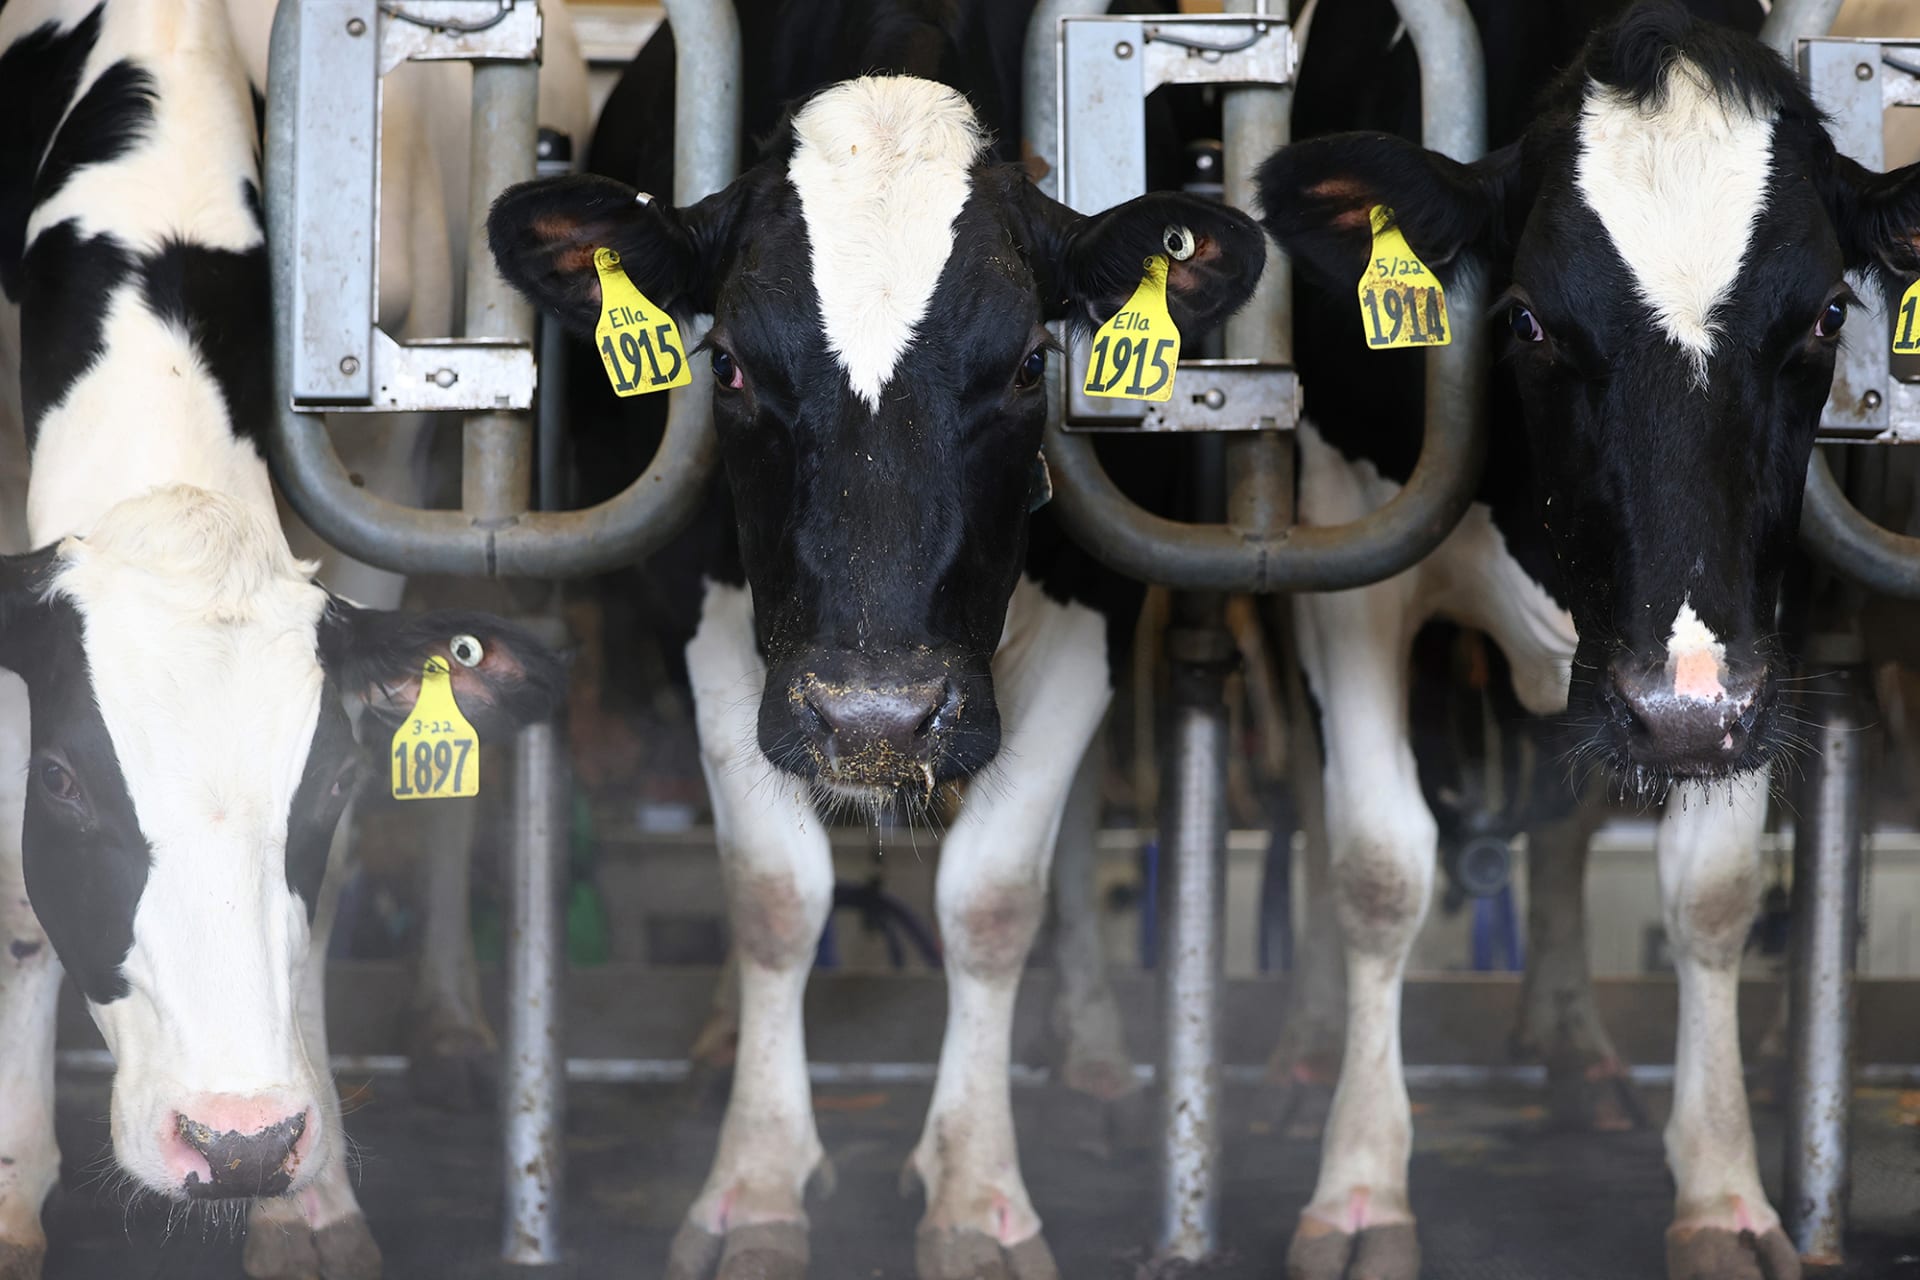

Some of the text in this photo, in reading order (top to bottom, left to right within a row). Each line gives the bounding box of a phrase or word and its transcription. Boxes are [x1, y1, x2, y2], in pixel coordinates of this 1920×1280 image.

[1376, 257, 1425, 278] 5/22
[608, 306, 648, 329] Ella
[1113, 312, 1150, 331] Ella
[1363, 286, 1445, 345] 1914
[1894, 296, 1920, 349] 1
[602, 323, 681, 392] 1915
[1085, 336, 1174, 396] 1915
[412, 720, 455, 735] 3-22
[395, 739, 472, 795] 1897
